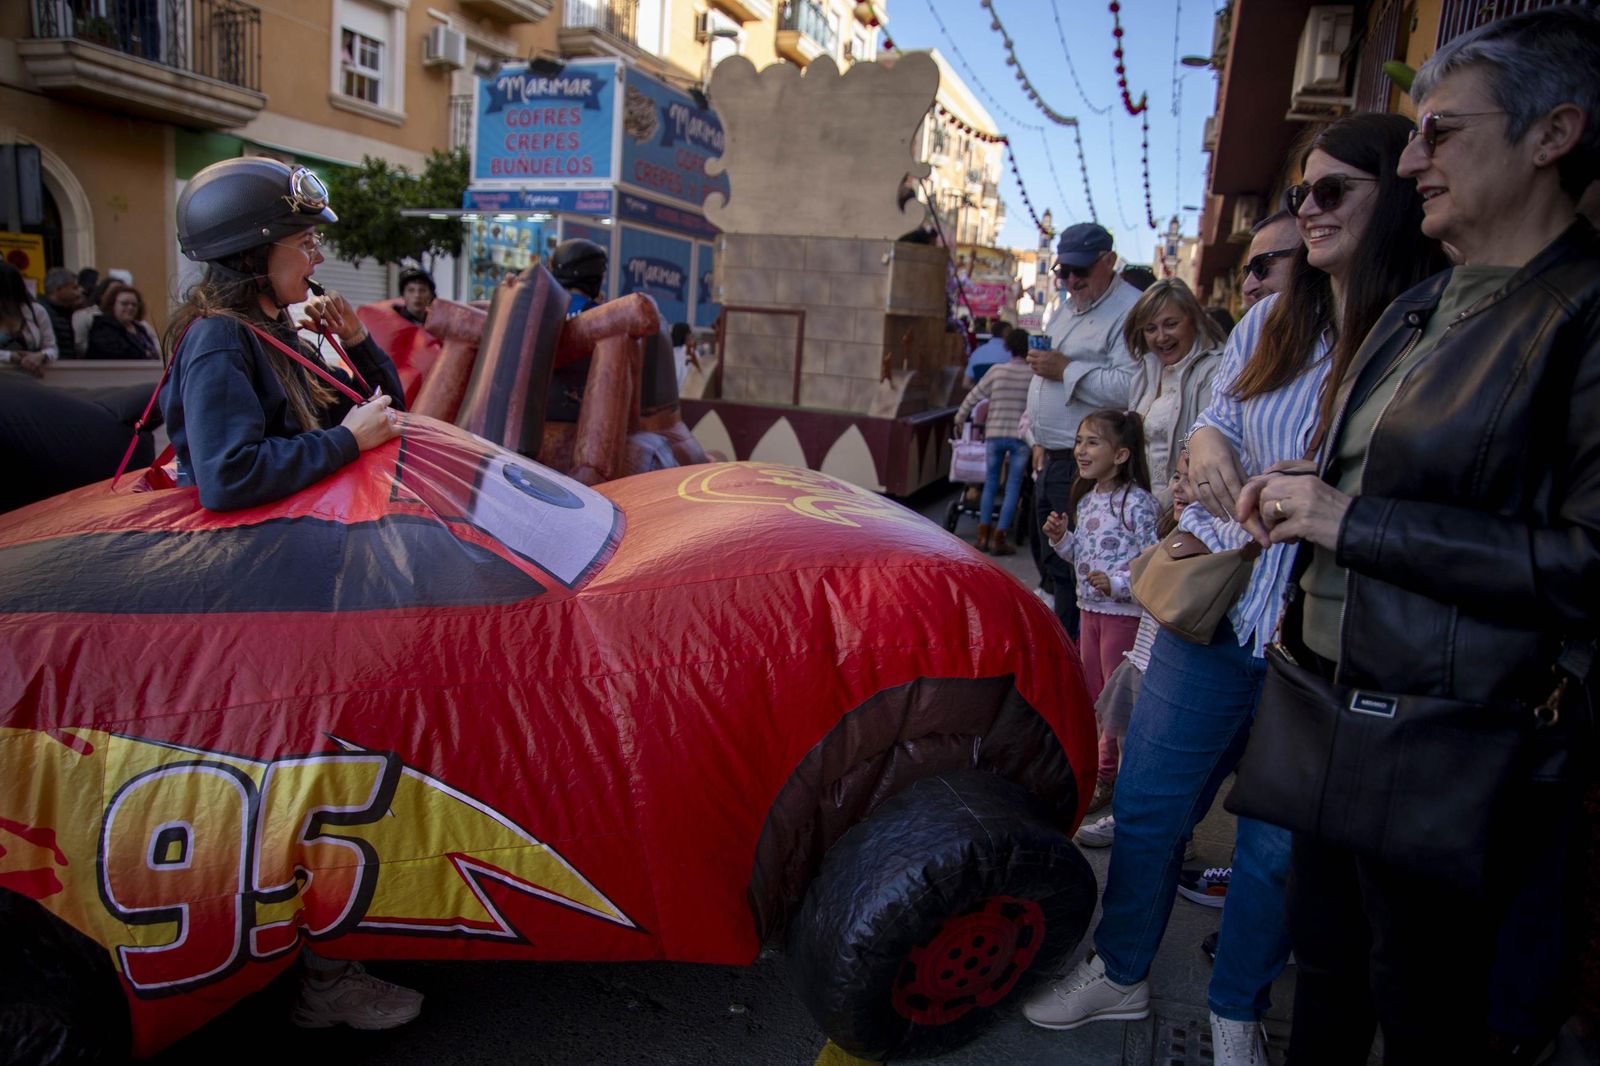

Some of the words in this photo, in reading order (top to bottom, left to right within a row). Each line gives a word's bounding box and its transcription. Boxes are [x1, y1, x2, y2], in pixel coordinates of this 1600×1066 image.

[505, 107, 582, 128] GOFRES
[505, 131, 580, 152] CREPES
[490, 153, 593, 176] BUÑUELOS
[98, 752, 400, 998] 95
